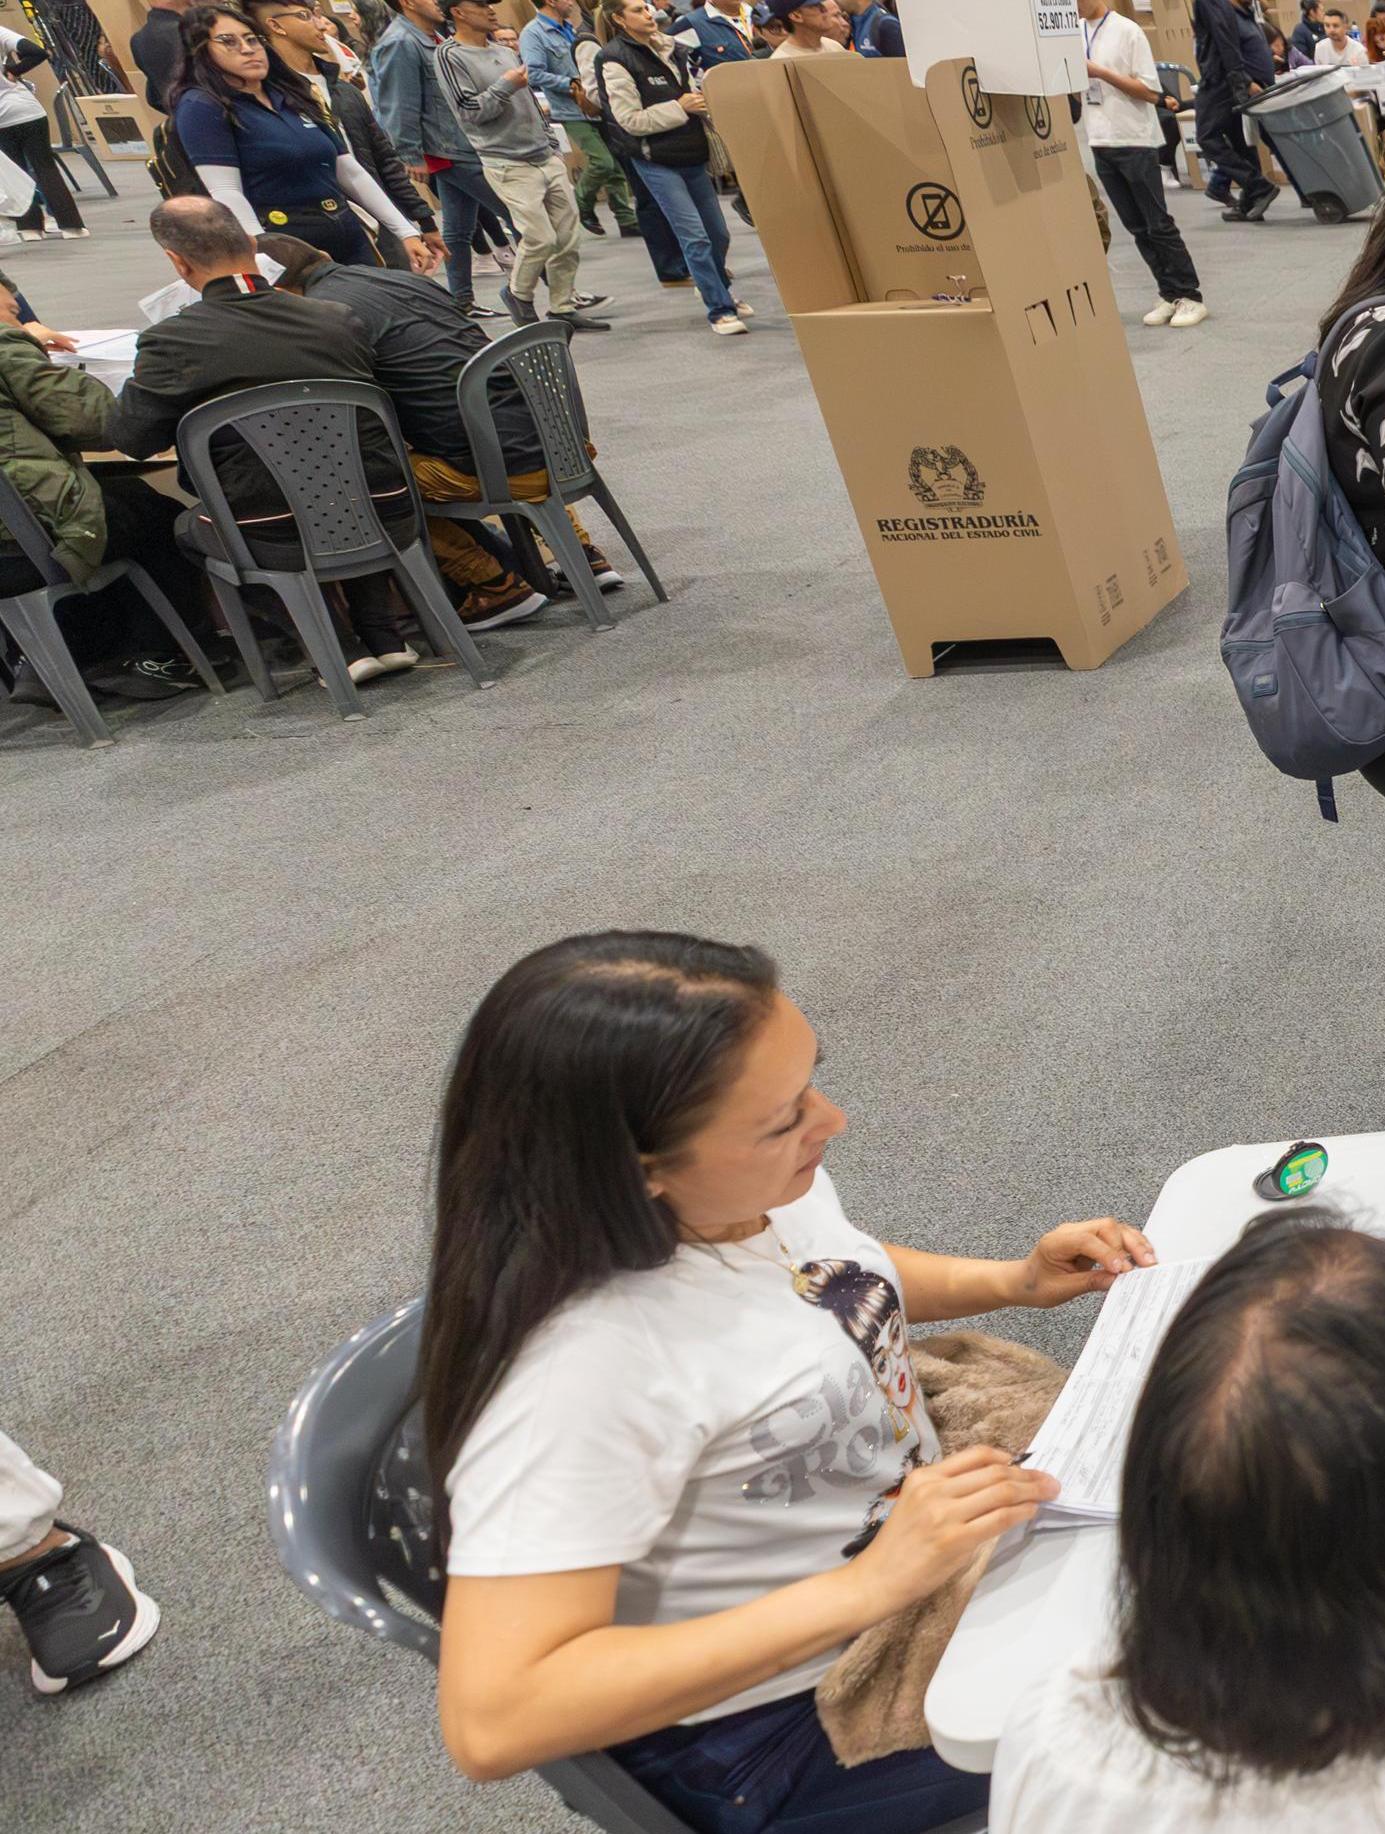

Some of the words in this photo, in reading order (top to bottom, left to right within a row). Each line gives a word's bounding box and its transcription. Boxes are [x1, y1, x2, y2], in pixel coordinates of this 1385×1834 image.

[1038, 12, 1078, 30] 52.907.172
[876, 510, 1039, 532] REGISTRADURÍA
[882, 531, 939, 542] NACIONAL
[941, 531, 964, 540] DEL
[967, 529, 1010, 539] ESTADO
[1014, 528, 1042, 537] CIVIL
